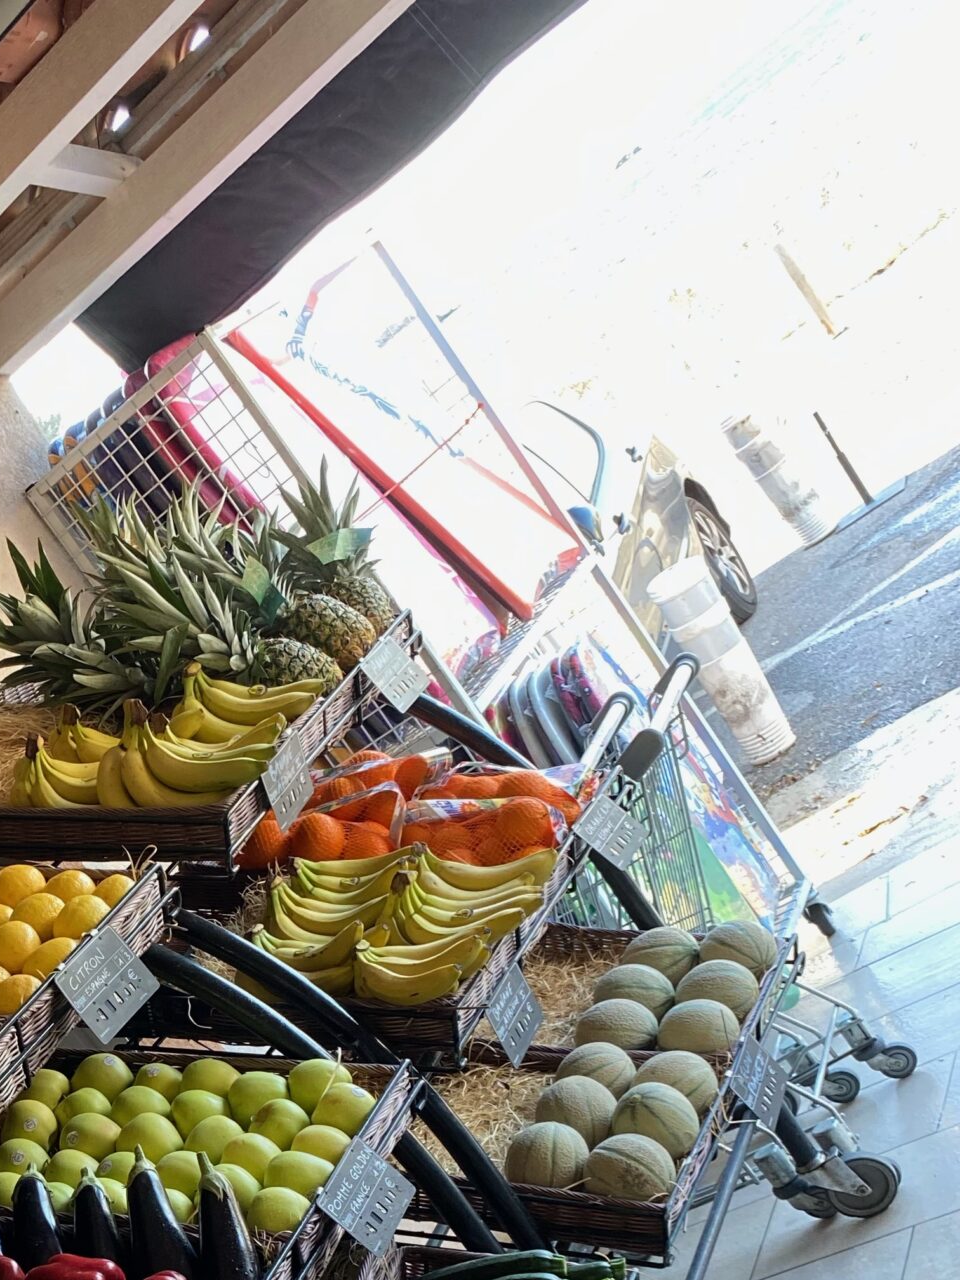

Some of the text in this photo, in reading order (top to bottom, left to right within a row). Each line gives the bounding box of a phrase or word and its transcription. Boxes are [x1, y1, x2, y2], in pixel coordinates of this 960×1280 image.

[69, 946, 106, 991] CITRON
[84, 967, 112, 997] ESPAGNE
[327, 1178, 353, 1217] POMME
[349, 1147, 374, 1180] GOLDEN
[350, 1181, 371, 1214] FRANCE
